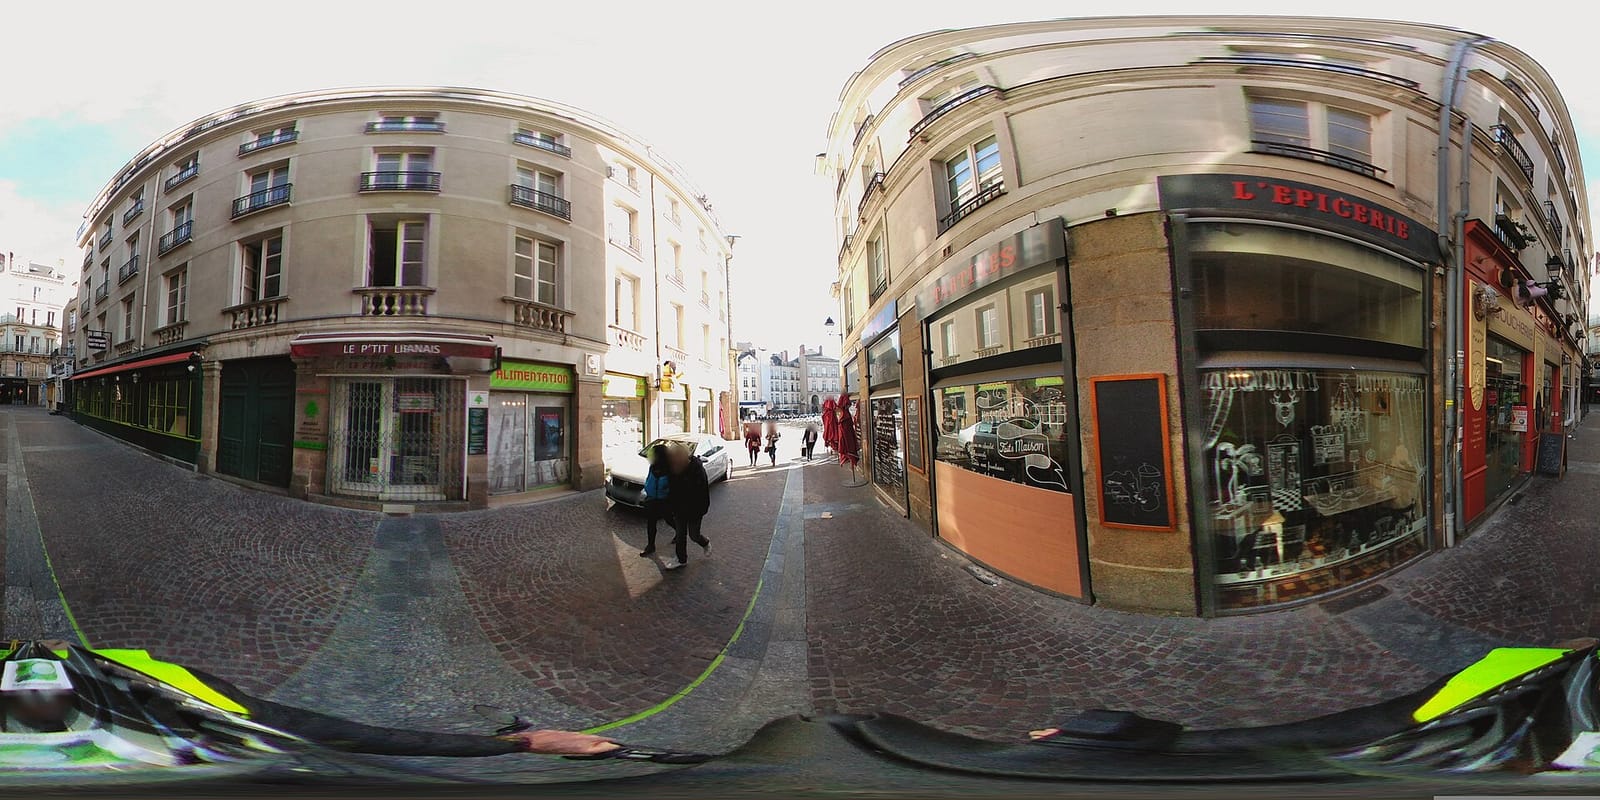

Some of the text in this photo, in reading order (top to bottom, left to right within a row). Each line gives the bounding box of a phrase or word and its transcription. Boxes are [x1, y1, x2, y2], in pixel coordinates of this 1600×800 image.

[1232, 181, 1409, 239] L'EPICERIE
[1493, 309, 1533, 340] OUCHERIE
[343, 343, 441, 354] LE P'TIT LIBANAIS
[496, 369, 568, 385] ALIMENTATION
[1015, 438, 1045, 453] Maison
